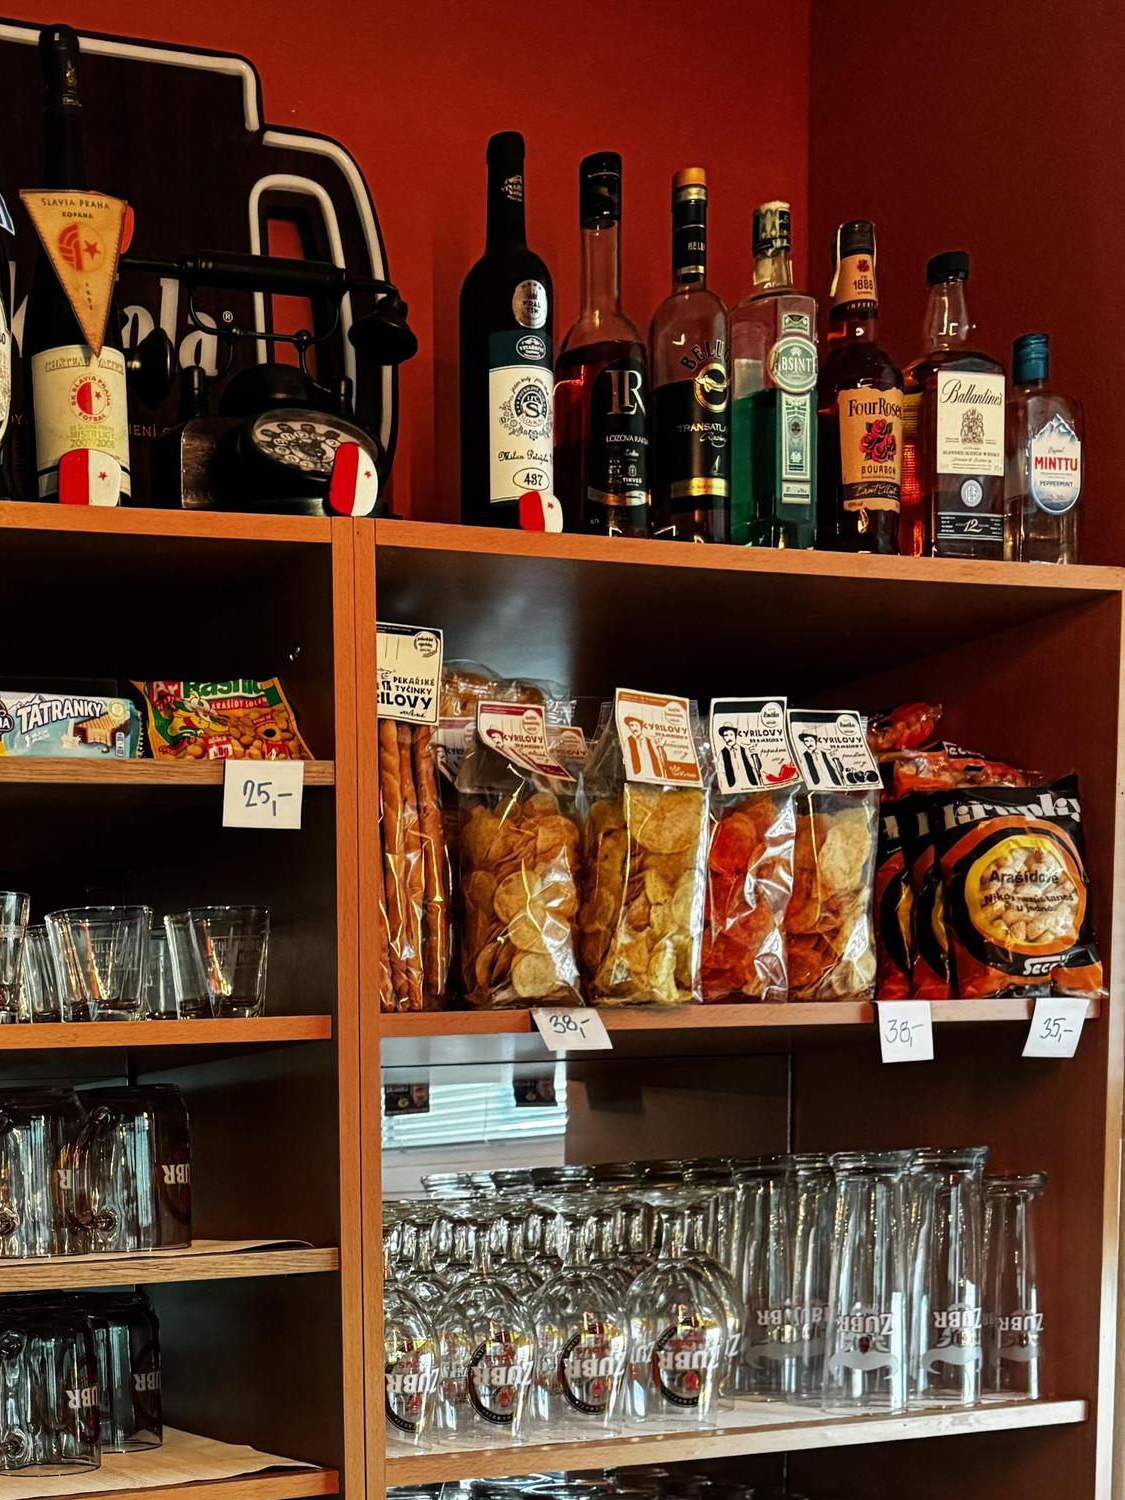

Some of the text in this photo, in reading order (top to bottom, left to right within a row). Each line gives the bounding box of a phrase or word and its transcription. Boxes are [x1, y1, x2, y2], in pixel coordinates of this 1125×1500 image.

[40, 198, 111, 209] SLAVIA PRAHA
[939, 378, 1003, 407] Ballantine's
[848, 398, 903, 418] Four Roses
[861, 464, 897, 474] BOURBON
[1034, 456, 1078, 472] MINTTU
[1039, 480, 1073, 488] PEPPERMINT
[963, 518, 983, 533] 12
[395, 684, 433, 696] TYČINKY
[376, 692, 433, 710] ILOVY
[17, 699, 103, 734] TATRANKY
[737, 728, 783, 738] CYRILOVY
[817, 736, 863, 744] CYRILOVY
[162, 1163, 190, 1184] UBR
[836, 1313, 895, 1336] ZUBR
[932, 1307, 981, 1328] ZUBR
[997, 1312, 1044, 1332] ZUBR
[564, 1351, 625, 1378] ZUBR
[657, 1348, 721, 1370] ZUBR
[133, 1370, 162, 1392] UBR
[385, 1367, 440, 1394] ZUBR
[471, 1360, 534, 1386] ZUBR
[65, 1386, 101, 1410] UBR
